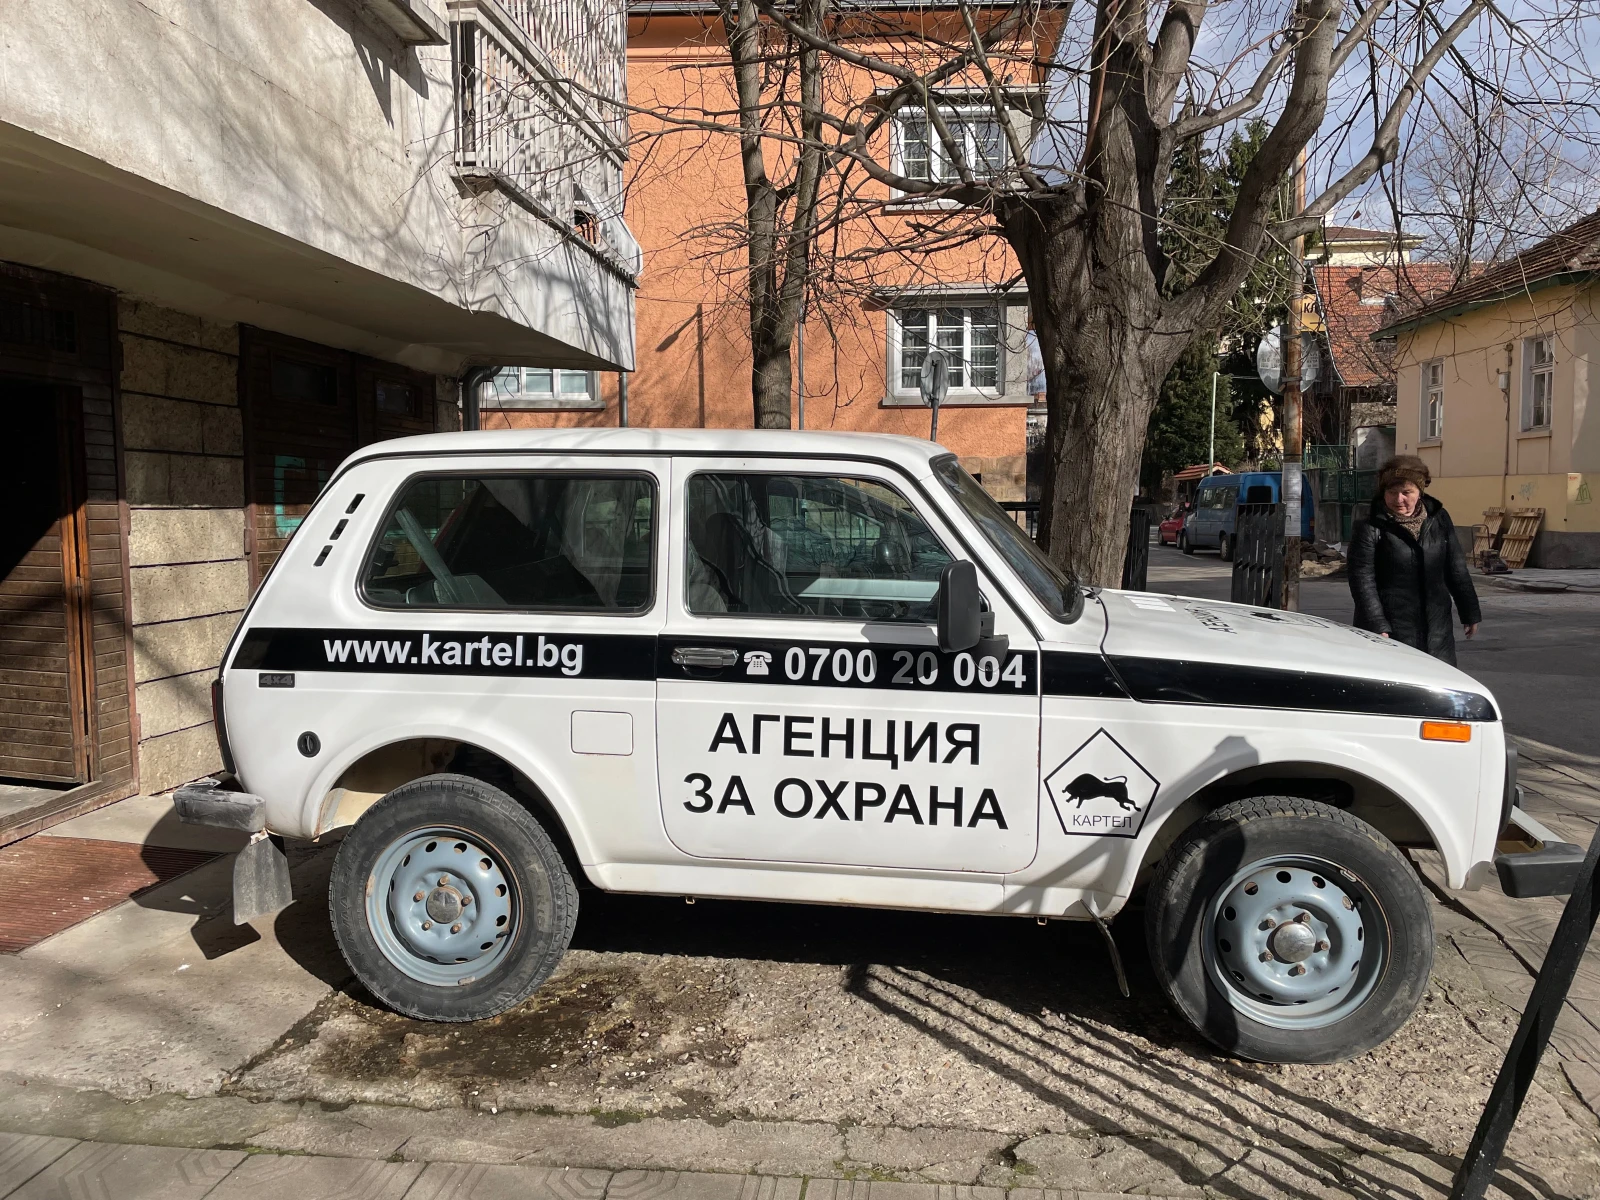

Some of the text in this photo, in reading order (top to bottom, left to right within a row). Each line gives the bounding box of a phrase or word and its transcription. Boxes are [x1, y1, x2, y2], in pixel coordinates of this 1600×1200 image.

[323, 633, 584, 676] www.kartel.bg
[784, 646, 1028, 689] 0700 20 004
[708, 712, 981, 770] АГЕНЦИЯ
[682, 772, 1009, 830] ЗА ОХРАНА
[1072, 813, 1133, 829] КАРТЕЛ
